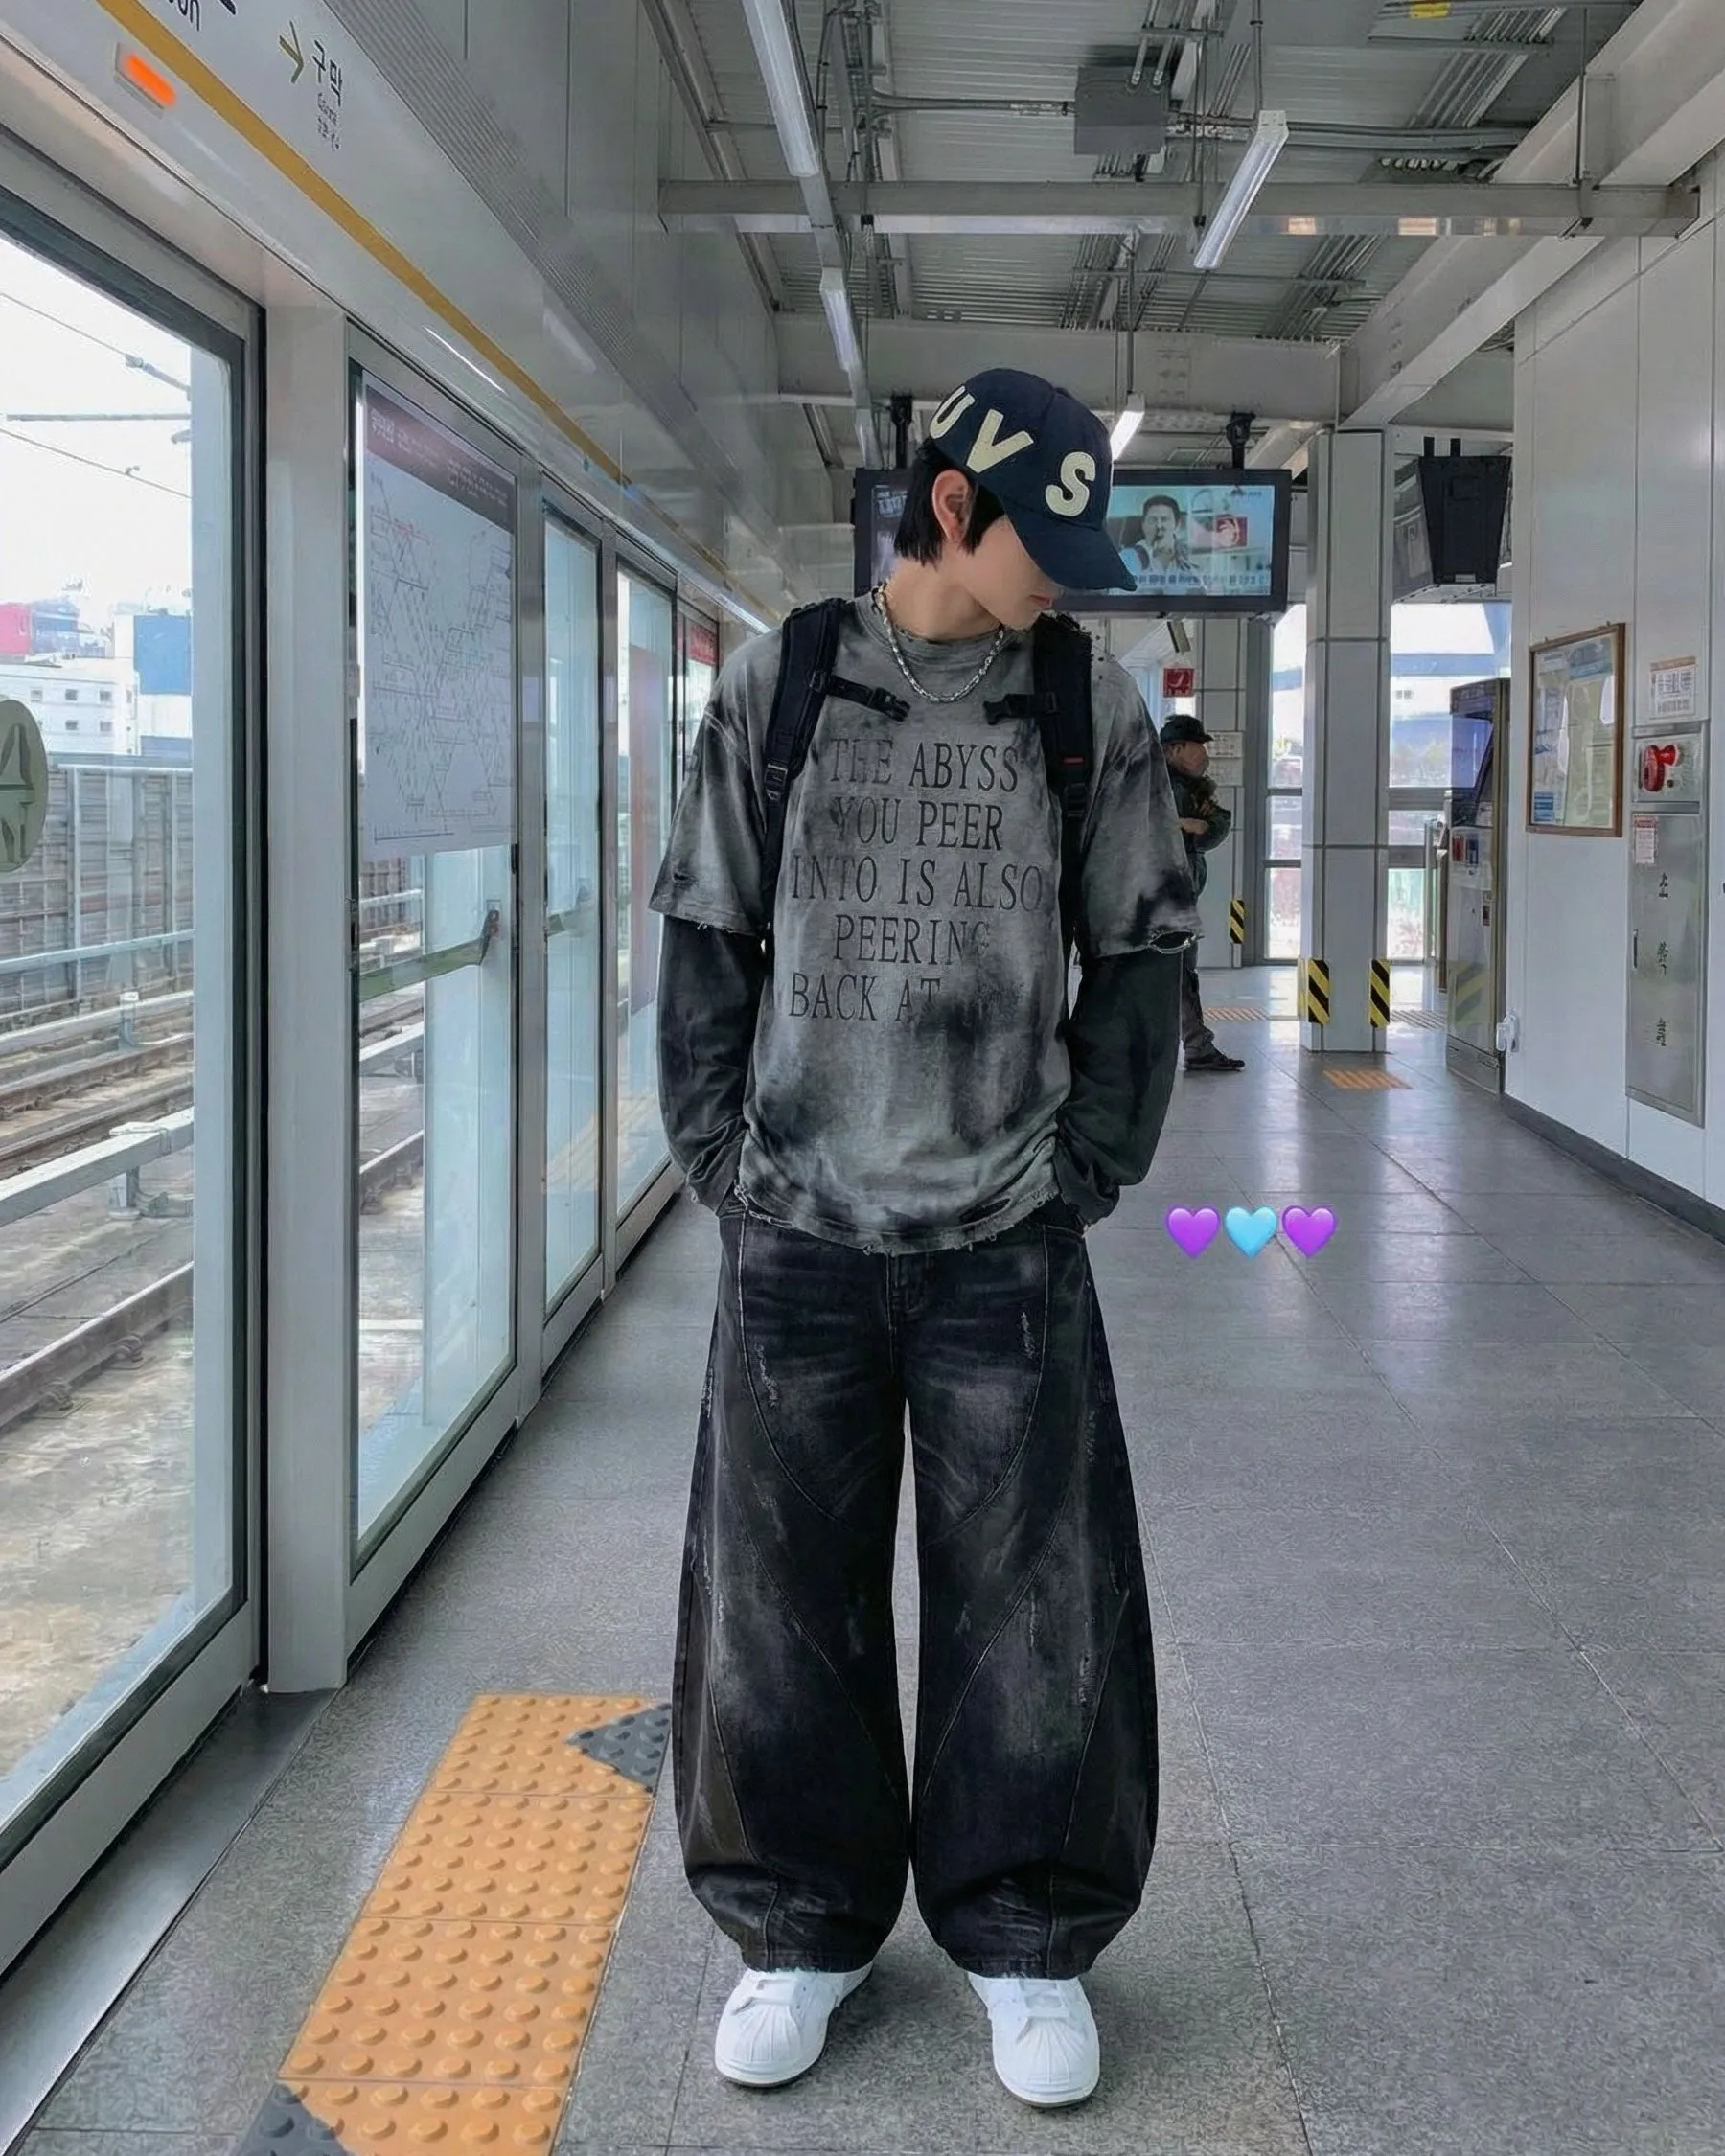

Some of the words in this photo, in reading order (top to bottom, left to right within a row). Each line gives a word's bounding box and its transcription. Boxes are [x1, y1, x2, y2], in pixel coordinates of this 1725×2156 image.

[908, 742, 1019, 792] ABYSS
[832, 796, 901, 844] YOU
[915, 800, 1002, 851] PEER
[792, 855, 877, 903] INTO
[897, 858, 935, 906] IS
[953, 861, 1043, 911] ALSO
[789, 971, 877, 1021] BACK
[894, 978, 940, 1021] AT
